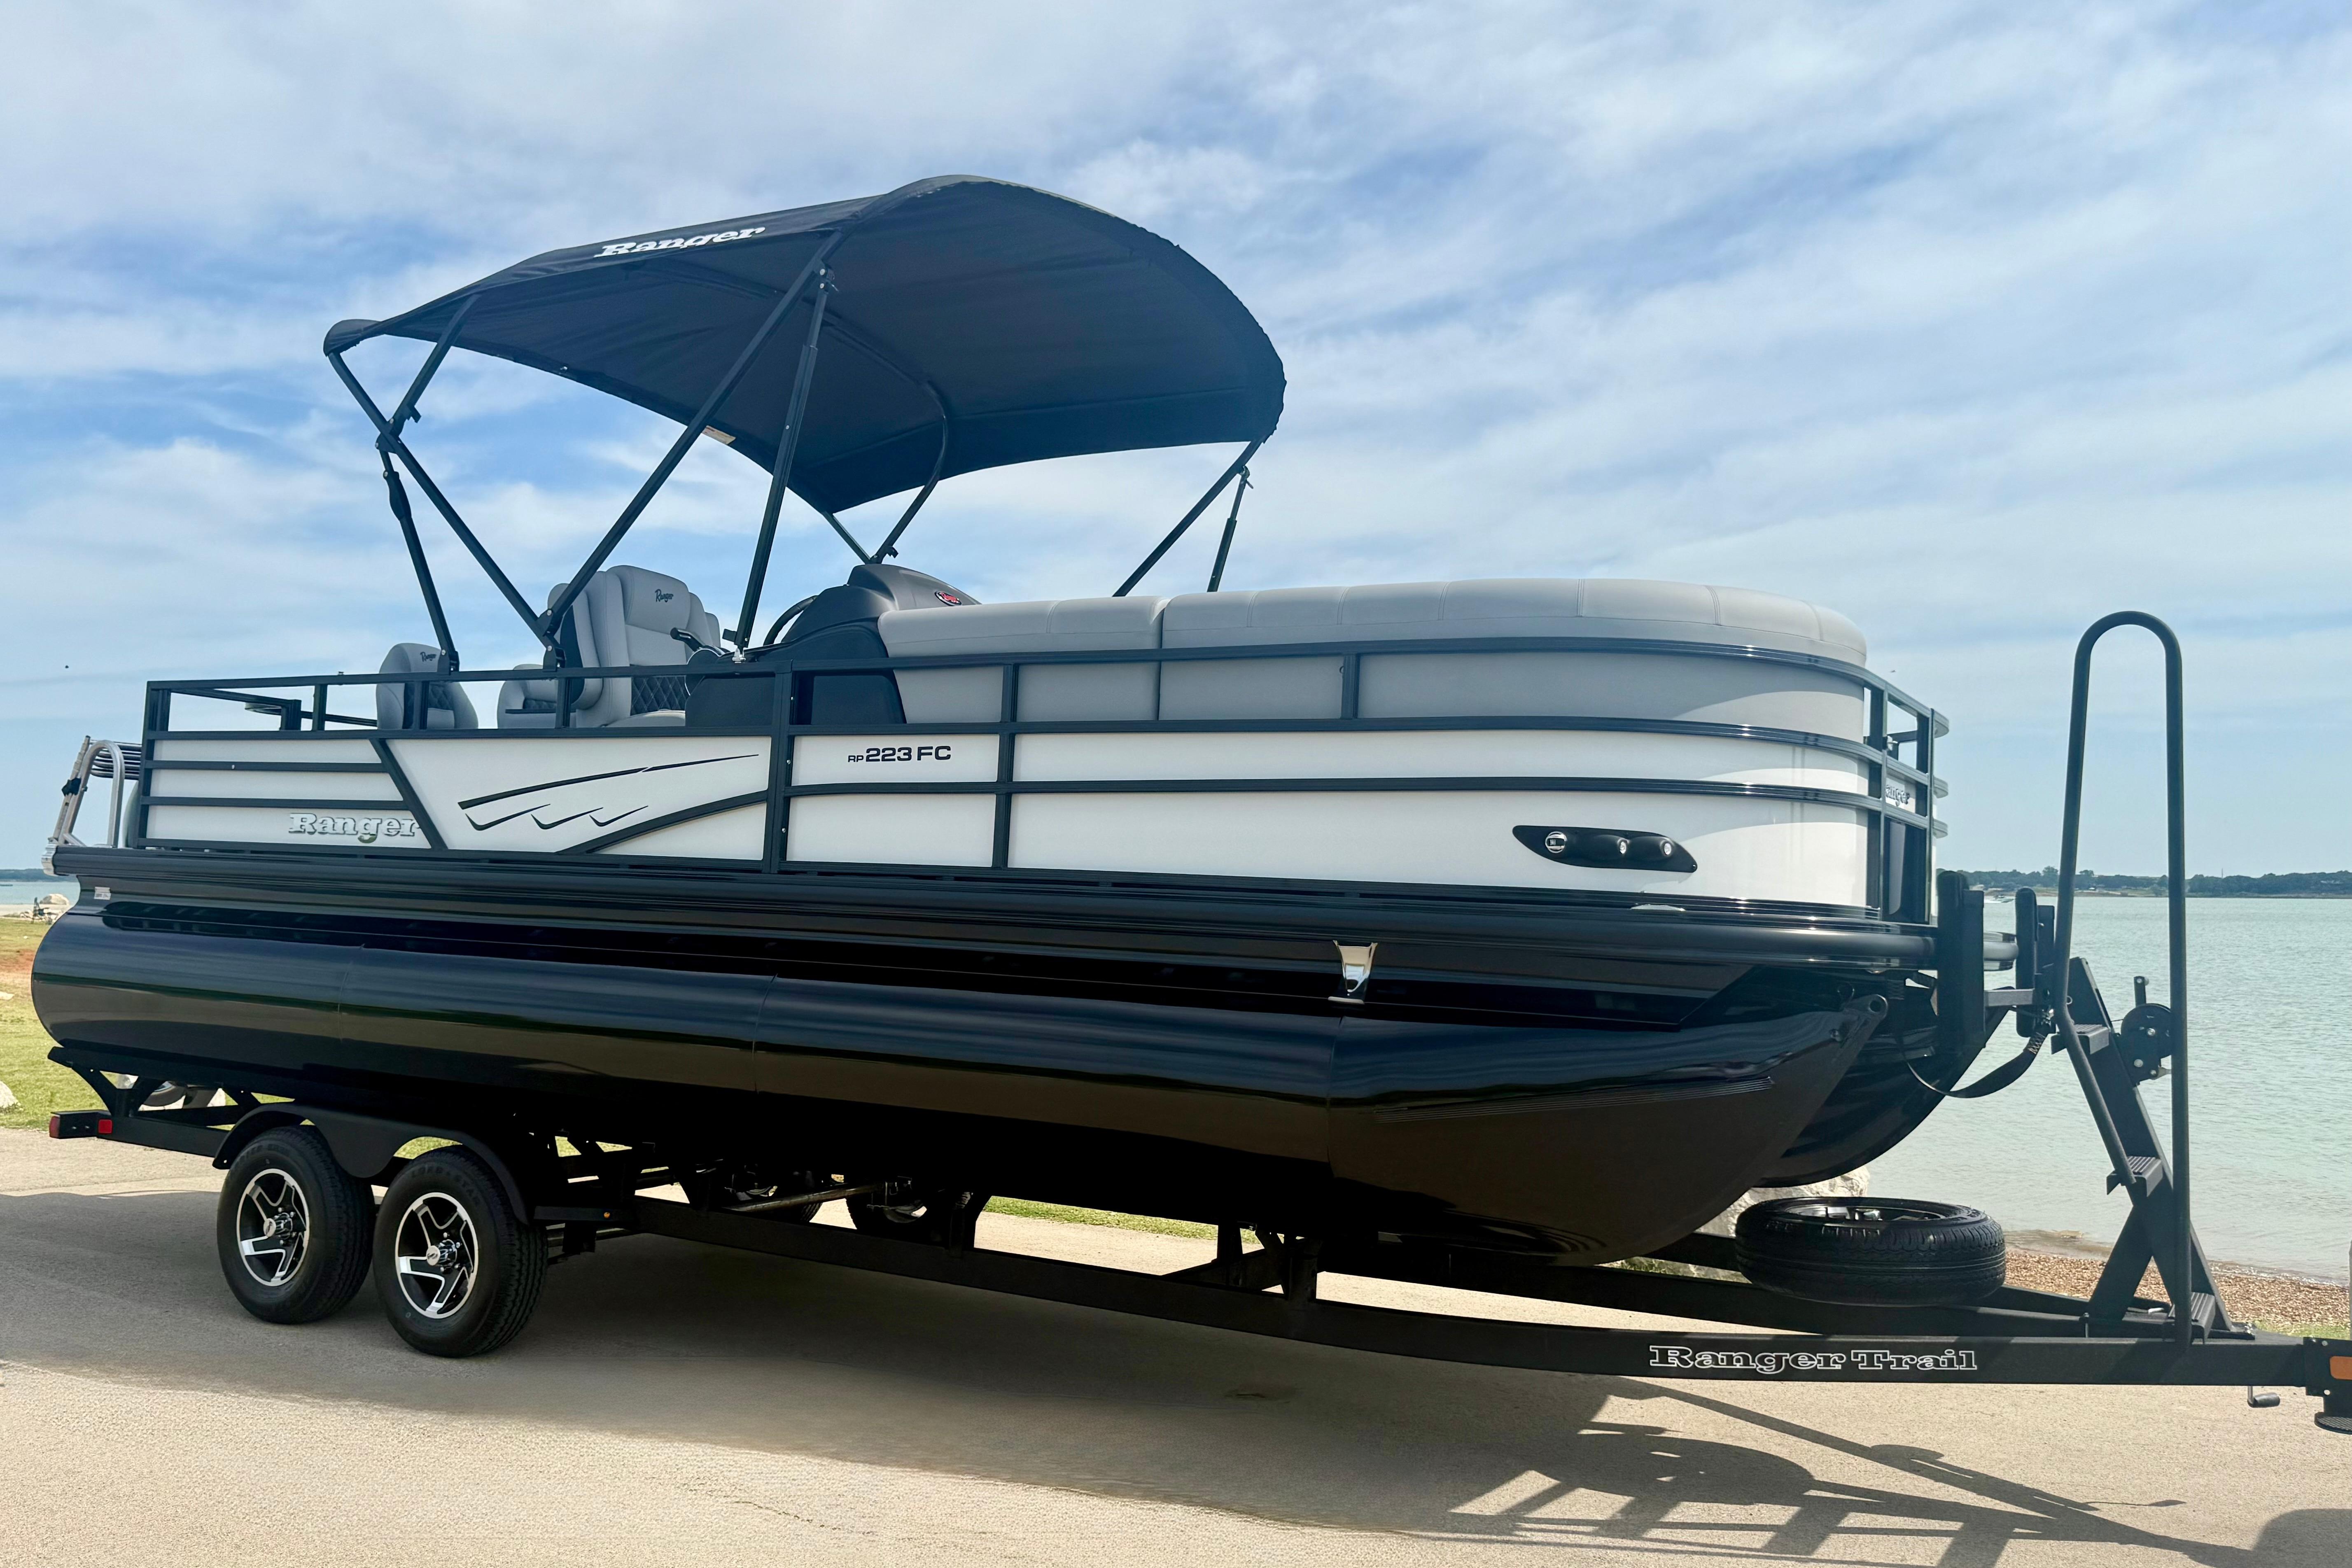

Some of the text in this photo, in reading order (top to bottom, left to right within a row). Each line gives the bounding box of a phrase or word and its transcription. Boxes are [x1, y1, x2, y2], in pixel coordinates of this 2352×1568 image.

[593, 226, 765, 258] Ranger
[917, 746, 951, 761] FC
[1885, 784, 1910, 807] anger
[288, 812, 421, 844] Ranger
[1650, 1345, 1978, 1374] Ranger Trail
